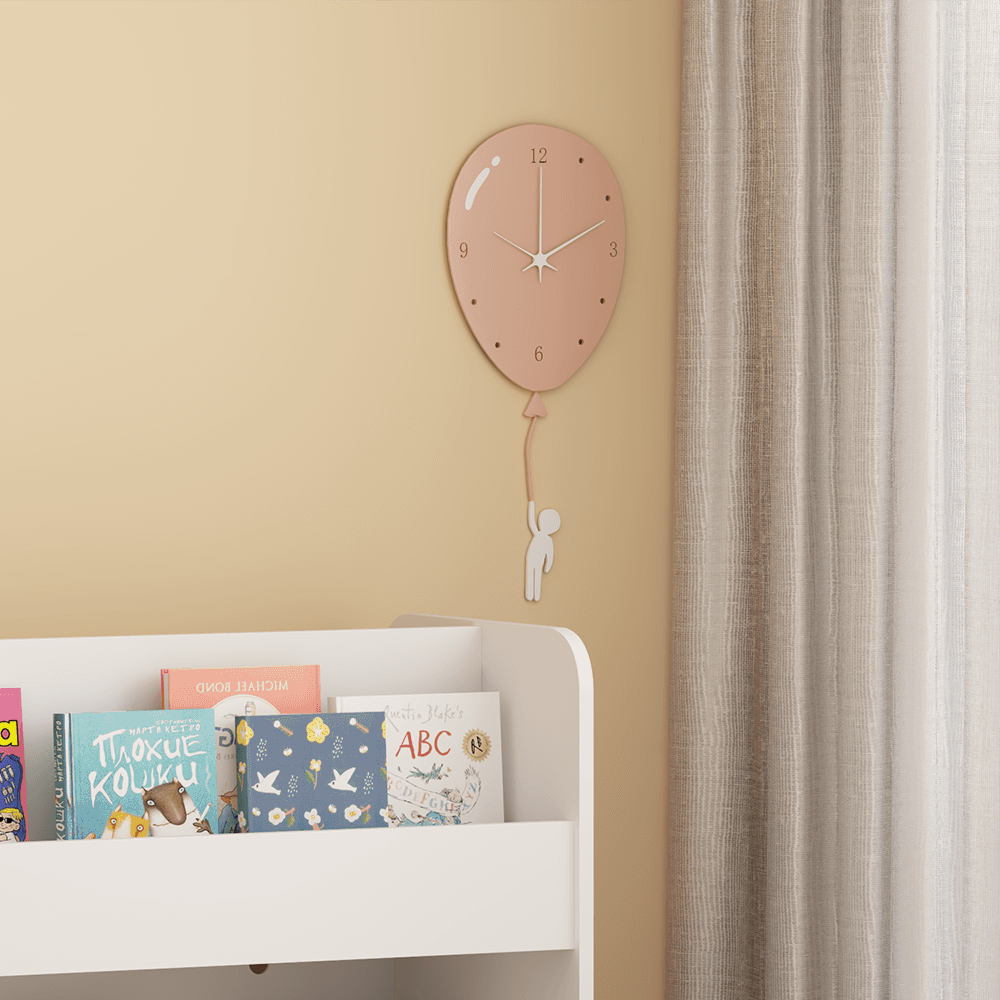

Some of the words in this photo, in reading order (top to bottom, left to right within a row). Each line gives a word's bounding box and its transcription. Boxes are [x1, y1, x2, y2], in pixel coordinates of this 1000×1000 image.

[530, 147, 548, 164] 12
[459, 242, 469, 258] 9
[609, 241, 618, 257] 3
[534, 346, 544, 362] 6
[165, 724, 201, 734] КЕТРО
[395, 729, 452, 759] ABC
